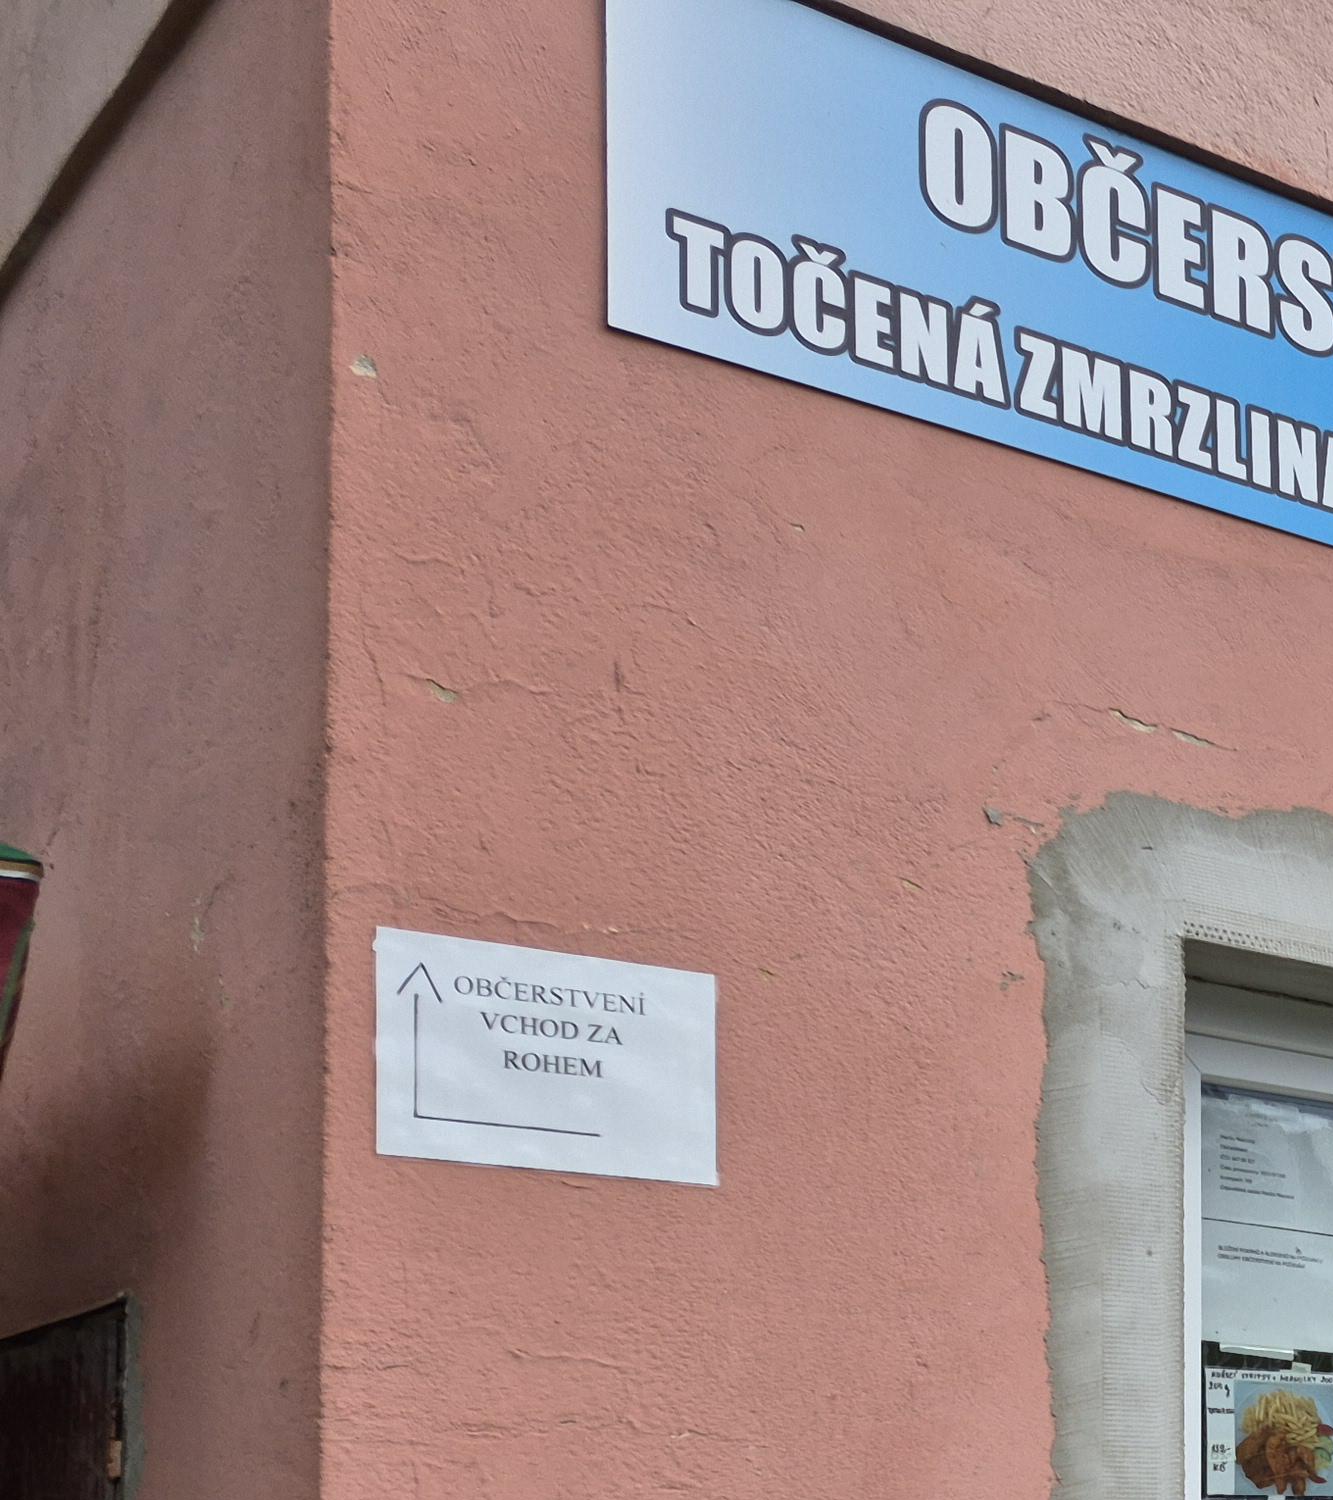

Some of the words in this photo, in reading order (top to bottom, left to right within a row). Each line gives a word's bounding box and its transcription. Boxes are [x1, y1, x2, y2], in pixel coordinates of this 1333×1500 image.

[665, 208, 1009, 411] TOČENÁ
[453, 975, 647, 1016] OBČERSTVENÍ
[480, 1011, 579, 1040] VCHOD
[587, 1024, 623, 1045] ZA
[503, 1049, 604, 1078] ROHEM
